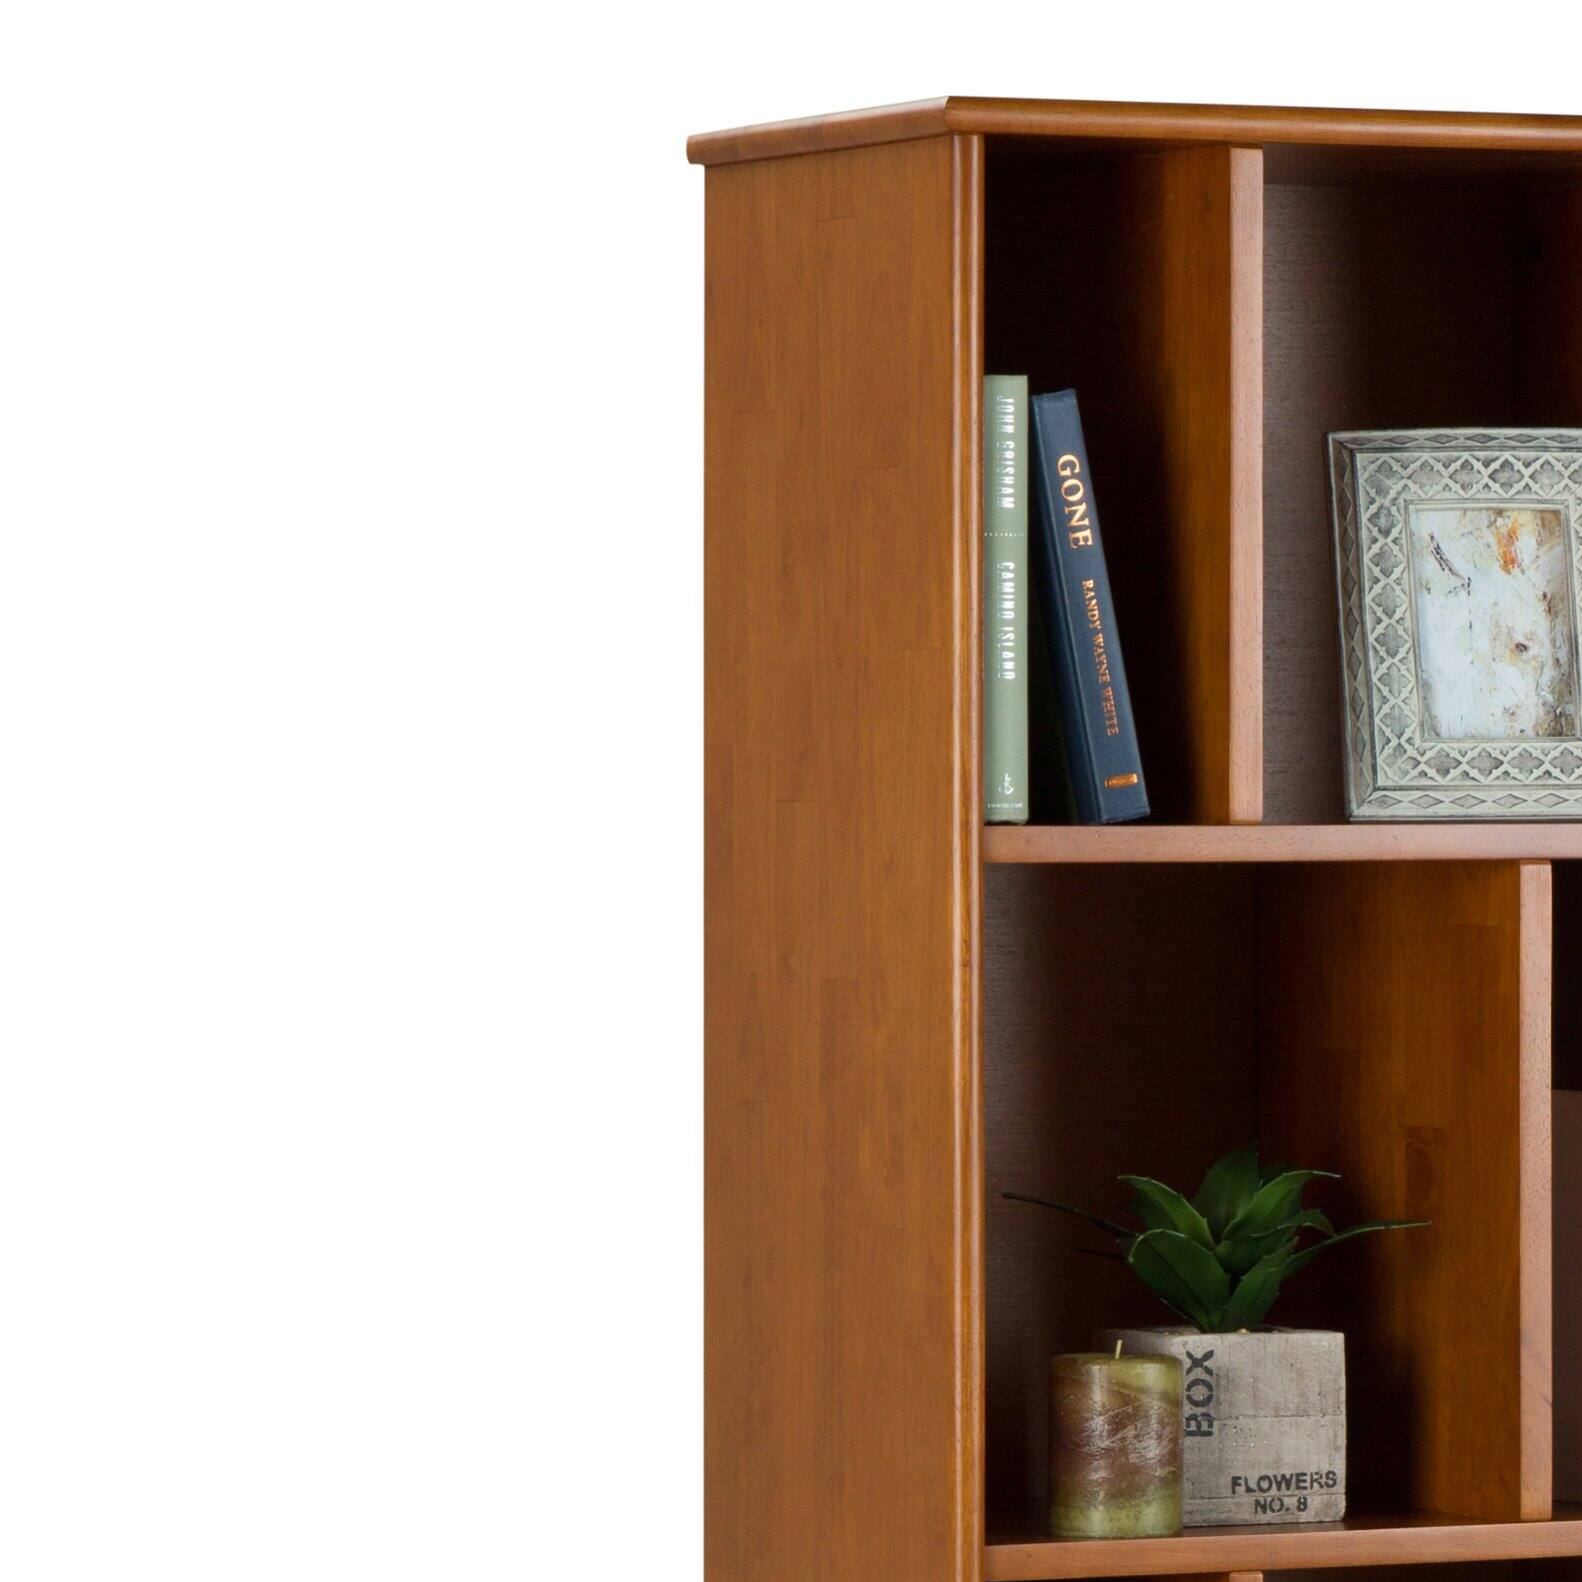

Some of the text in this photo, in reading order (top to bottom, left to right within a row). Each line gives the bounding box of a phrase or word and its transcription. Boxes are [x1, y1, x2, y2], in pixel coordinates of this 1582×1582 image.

[1057, 453, 1093, 549] GONE
[1082, 578, 1102, 630] RANDY
[1092, 632, 1112, 683] WAYNE
[1184, 1349, 1215, 1437] BOX
[1231, 1470, 1338, 1495] FLOWERS
[1254, 1496, 1308, 1514] NO. 8
